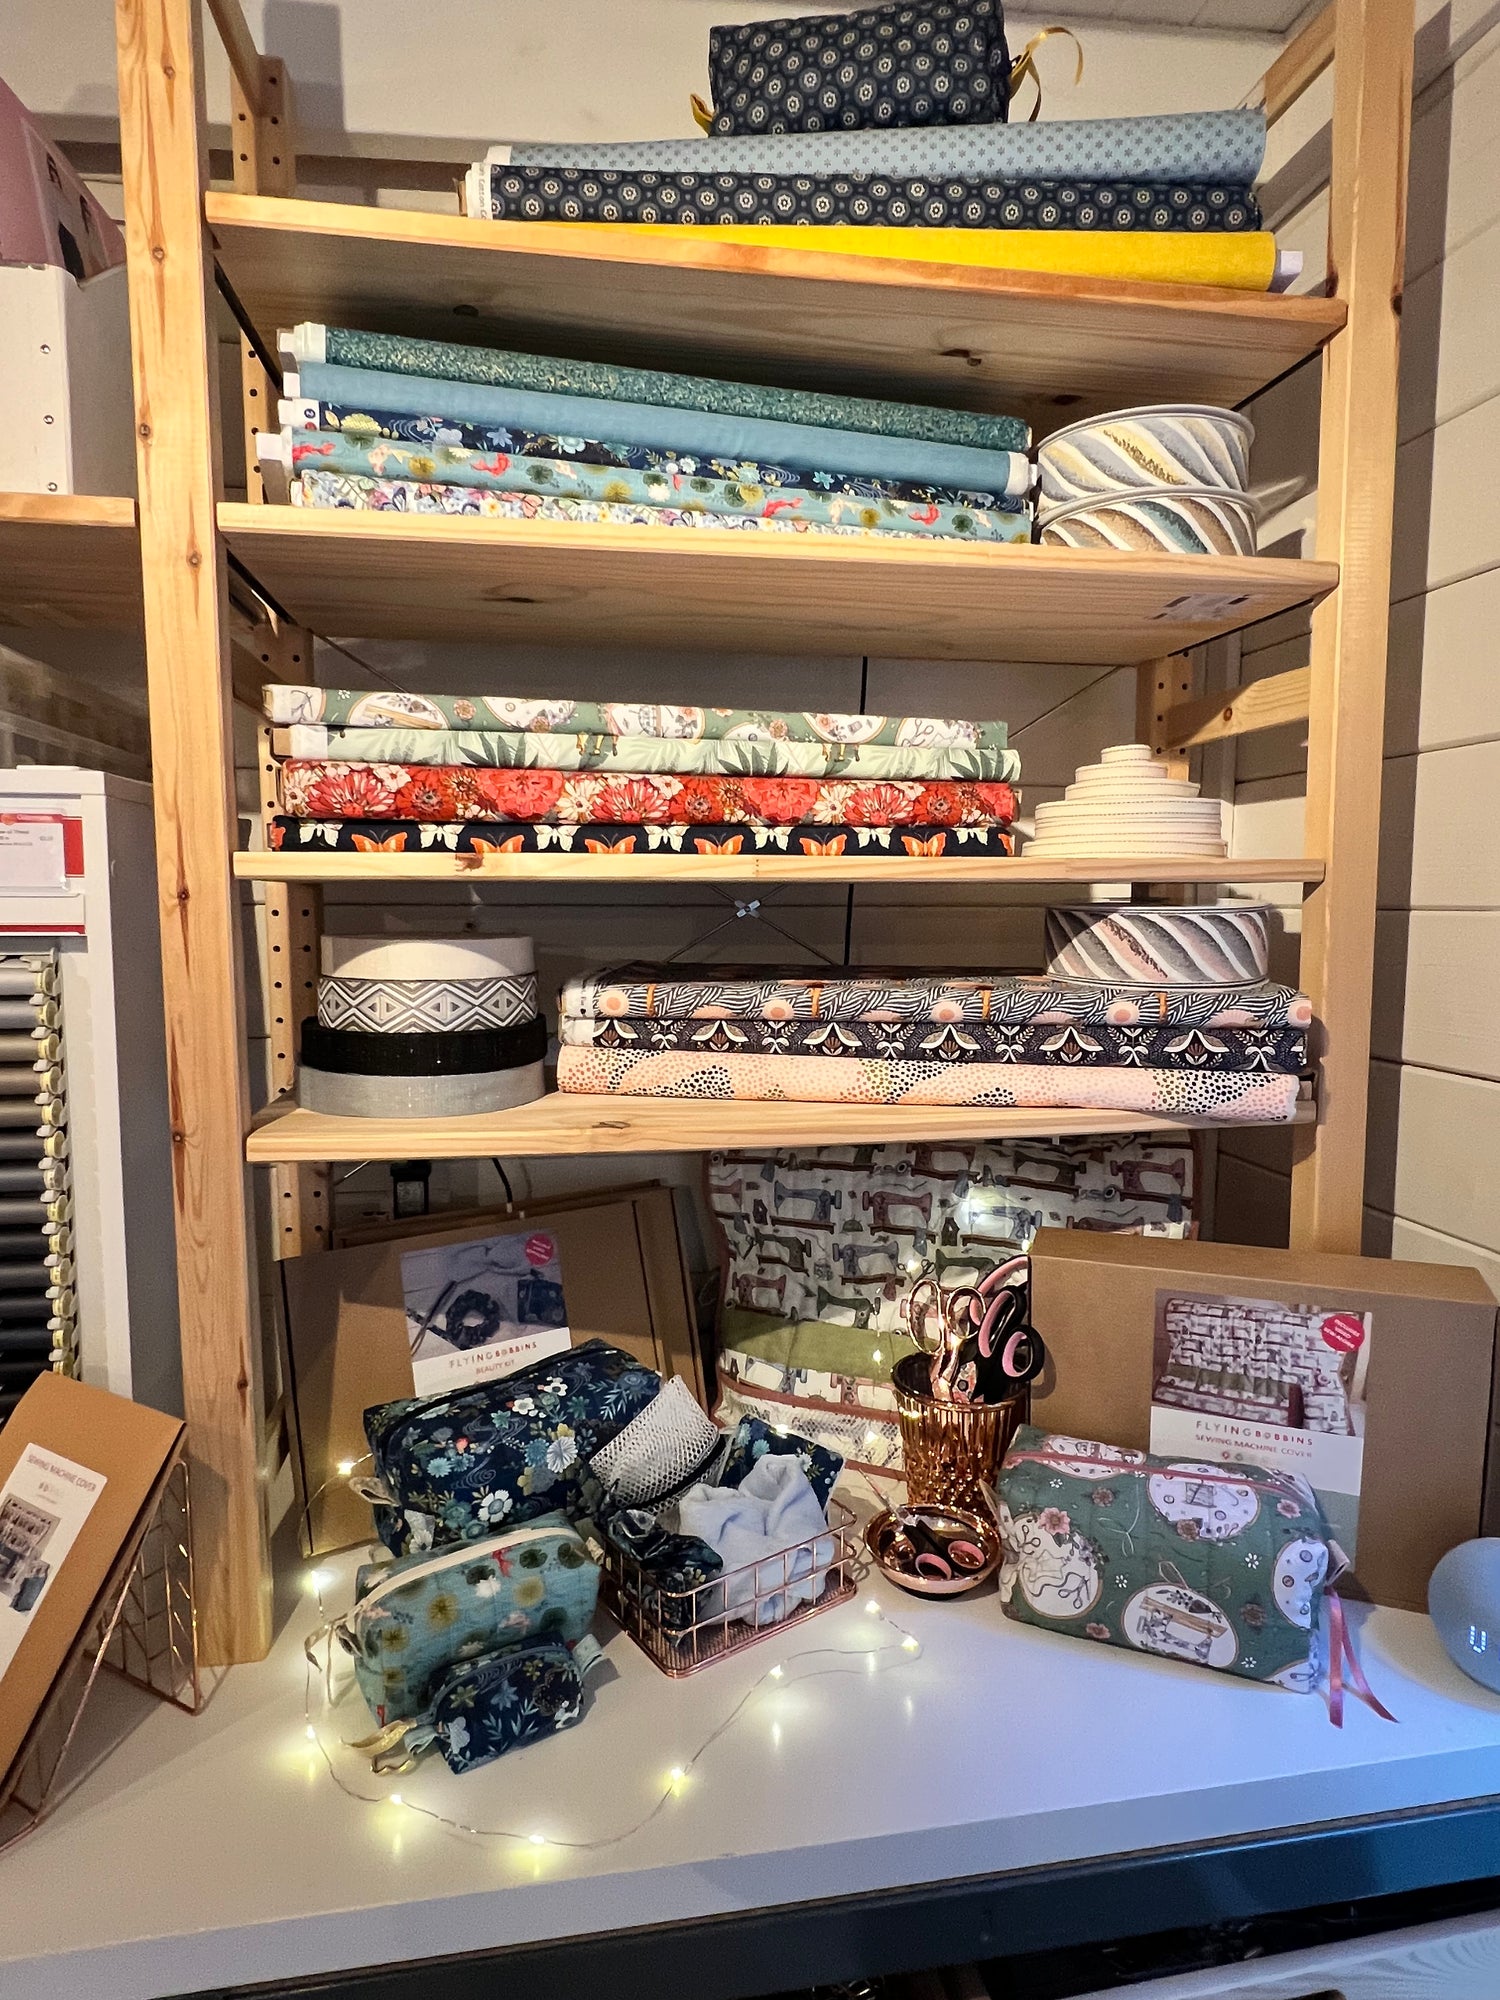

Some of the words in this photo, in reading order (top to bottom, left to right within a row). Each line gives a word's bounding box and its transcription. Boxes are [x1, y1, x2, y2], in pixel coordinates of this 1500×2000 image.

[475, 1363, 502, 1375] BEAUTY
[504, 1360, 515, 1368] KIT
[1195, 1434, 1232, 1446] SEWING
[1234, 1441, 1277, 1453] MACHINE
[1281, 1448, 1312, 1458] COVER
[76, 1477, 97, 1492] COVER
